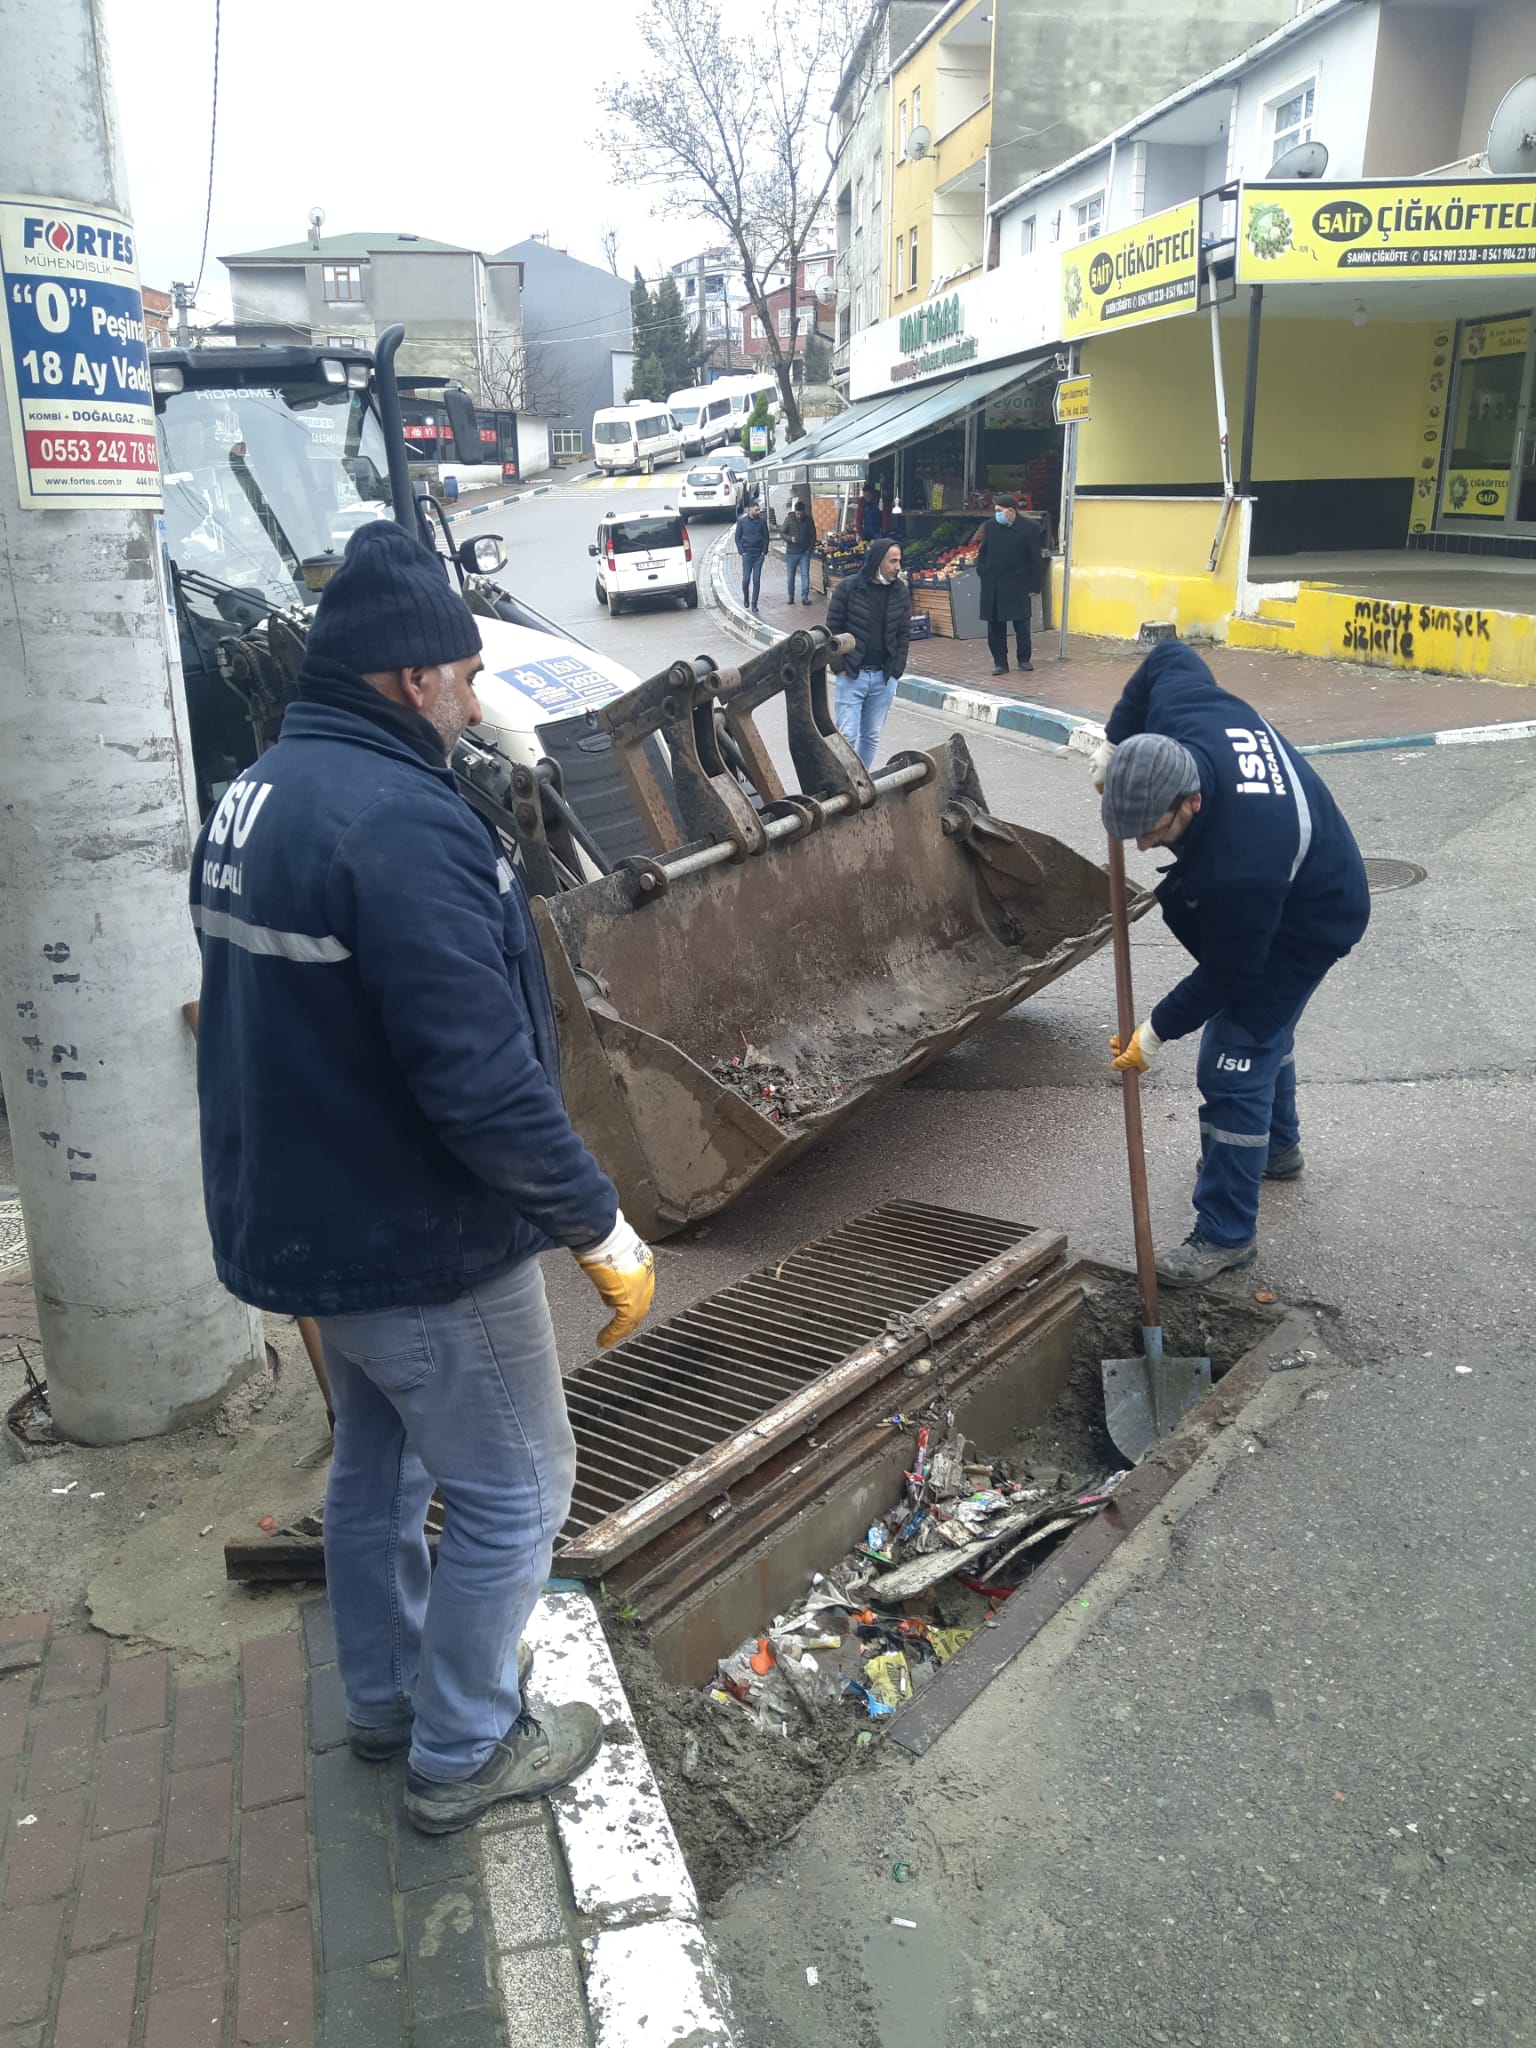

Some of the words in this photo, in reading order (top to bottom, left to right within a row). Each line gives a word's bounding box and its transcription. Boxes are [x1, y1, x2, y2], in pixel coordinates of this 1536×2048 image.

[1318, 207, 1364, 234] SAİT
[24, 217, 134, 265] FORTES
[24, 252, 112, 275] MÜHENDİSLİK
[1091, 259, 1112, 289] SAİT
[1116, 219, 1195, 290] ÇİĞKÖFTECİ
[1347, 250, 1371, 265] ŞAHİN
[1372, 249, 1409, 264] ÇİĞKÖFTE
[1429, 249, 1442, 262] 541
[1443, 249, 1457, 262] 901
[1489, 247, 1502, 260] 541
[22, 350, 63, 385] 18
[72, 353, 108, 395] Ay
[29, 411, 61, 421] KOMBİ
[72, 410, 134, 424] DOĞALGAZ
[40, 438, 92, 462] 0553
[96, 439, 128, 463] 242
[129, 441, 146, 464] 78
[45, 476, 122, 487] www.fortes.com.tr
[566, 672, 602, 688] 2022
